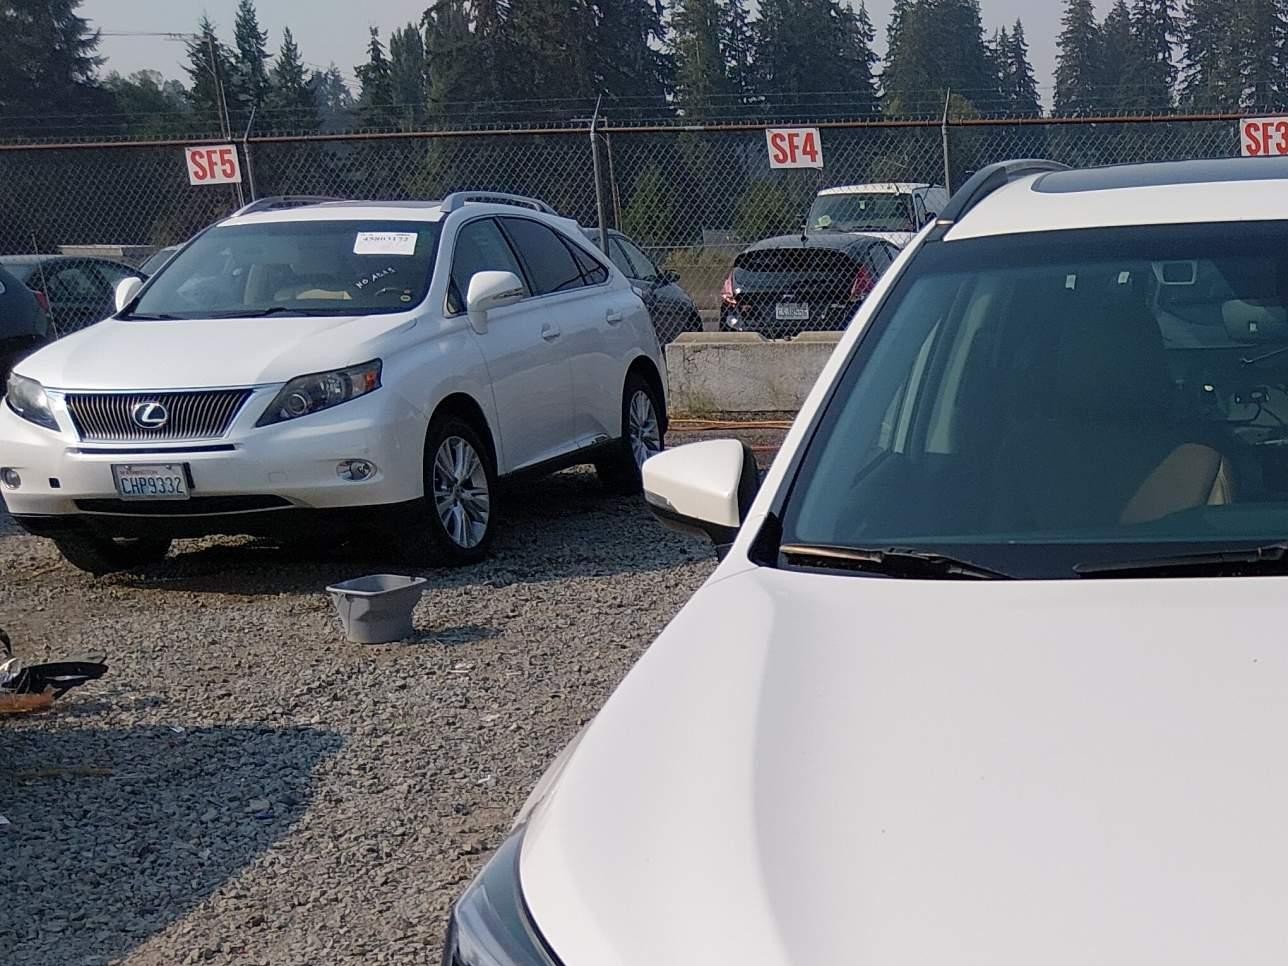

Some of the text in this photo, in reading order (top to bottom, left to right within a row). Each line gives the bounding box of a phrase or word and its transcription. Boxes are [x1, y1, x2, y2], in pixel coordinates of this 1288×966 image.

[770, 132, 818, 164] SF4
[189, 148, 236, 181] SF5
[120, 476, 184, 494] CHP9332
